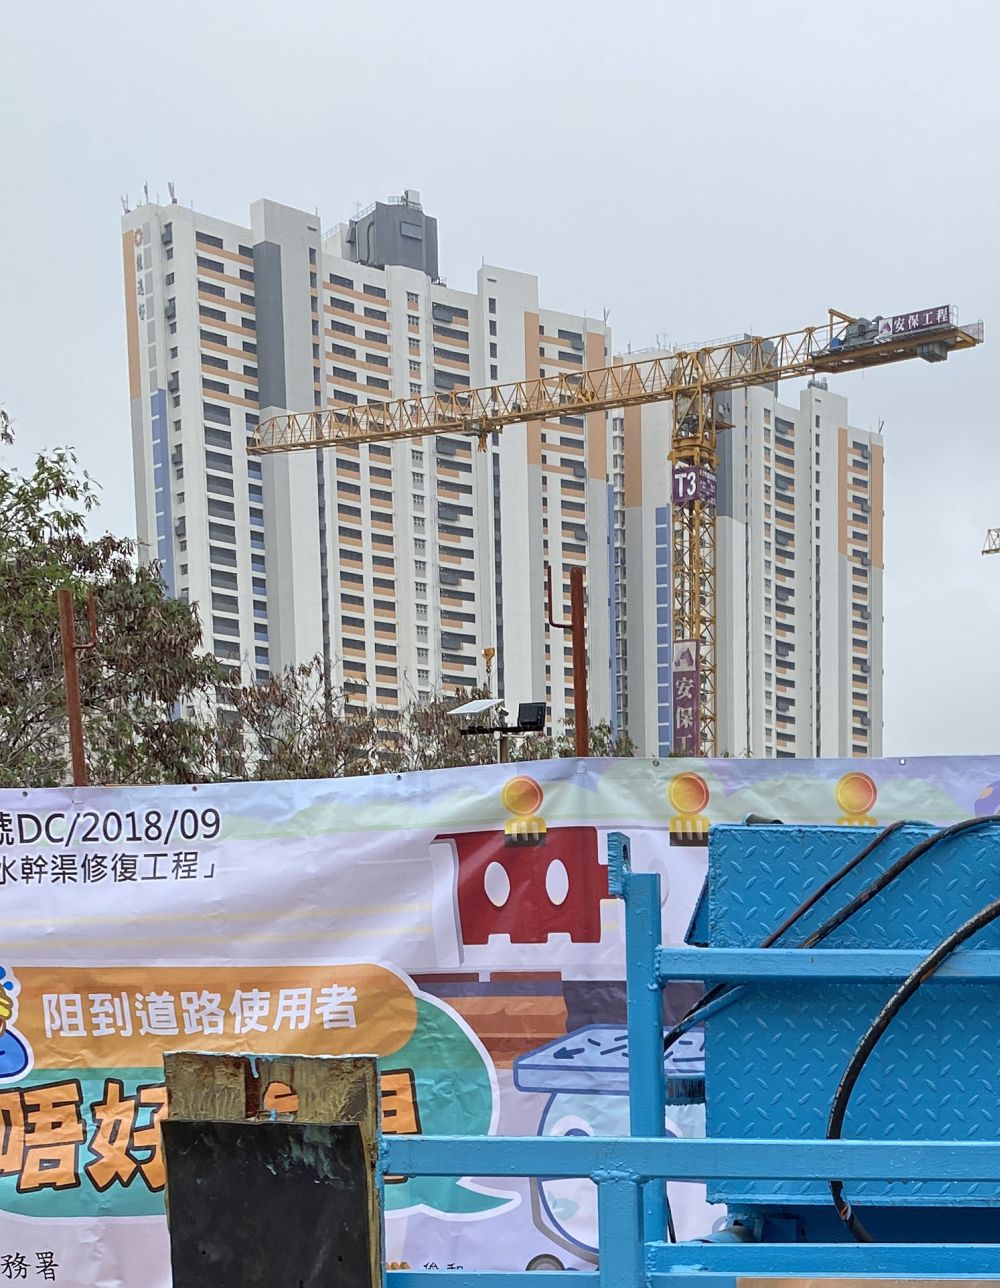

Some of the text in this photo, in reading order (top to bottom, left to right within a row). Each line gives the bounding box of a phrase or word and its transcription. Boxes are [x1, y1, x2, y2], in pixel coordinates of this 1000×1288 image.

[893, 307, 949, 333] 安保工程
[674, 471, 697, 498] T3
[42, 984, 358, 1039] 阻到道路使用者
[0, 1251, 59, 1281] 務署
